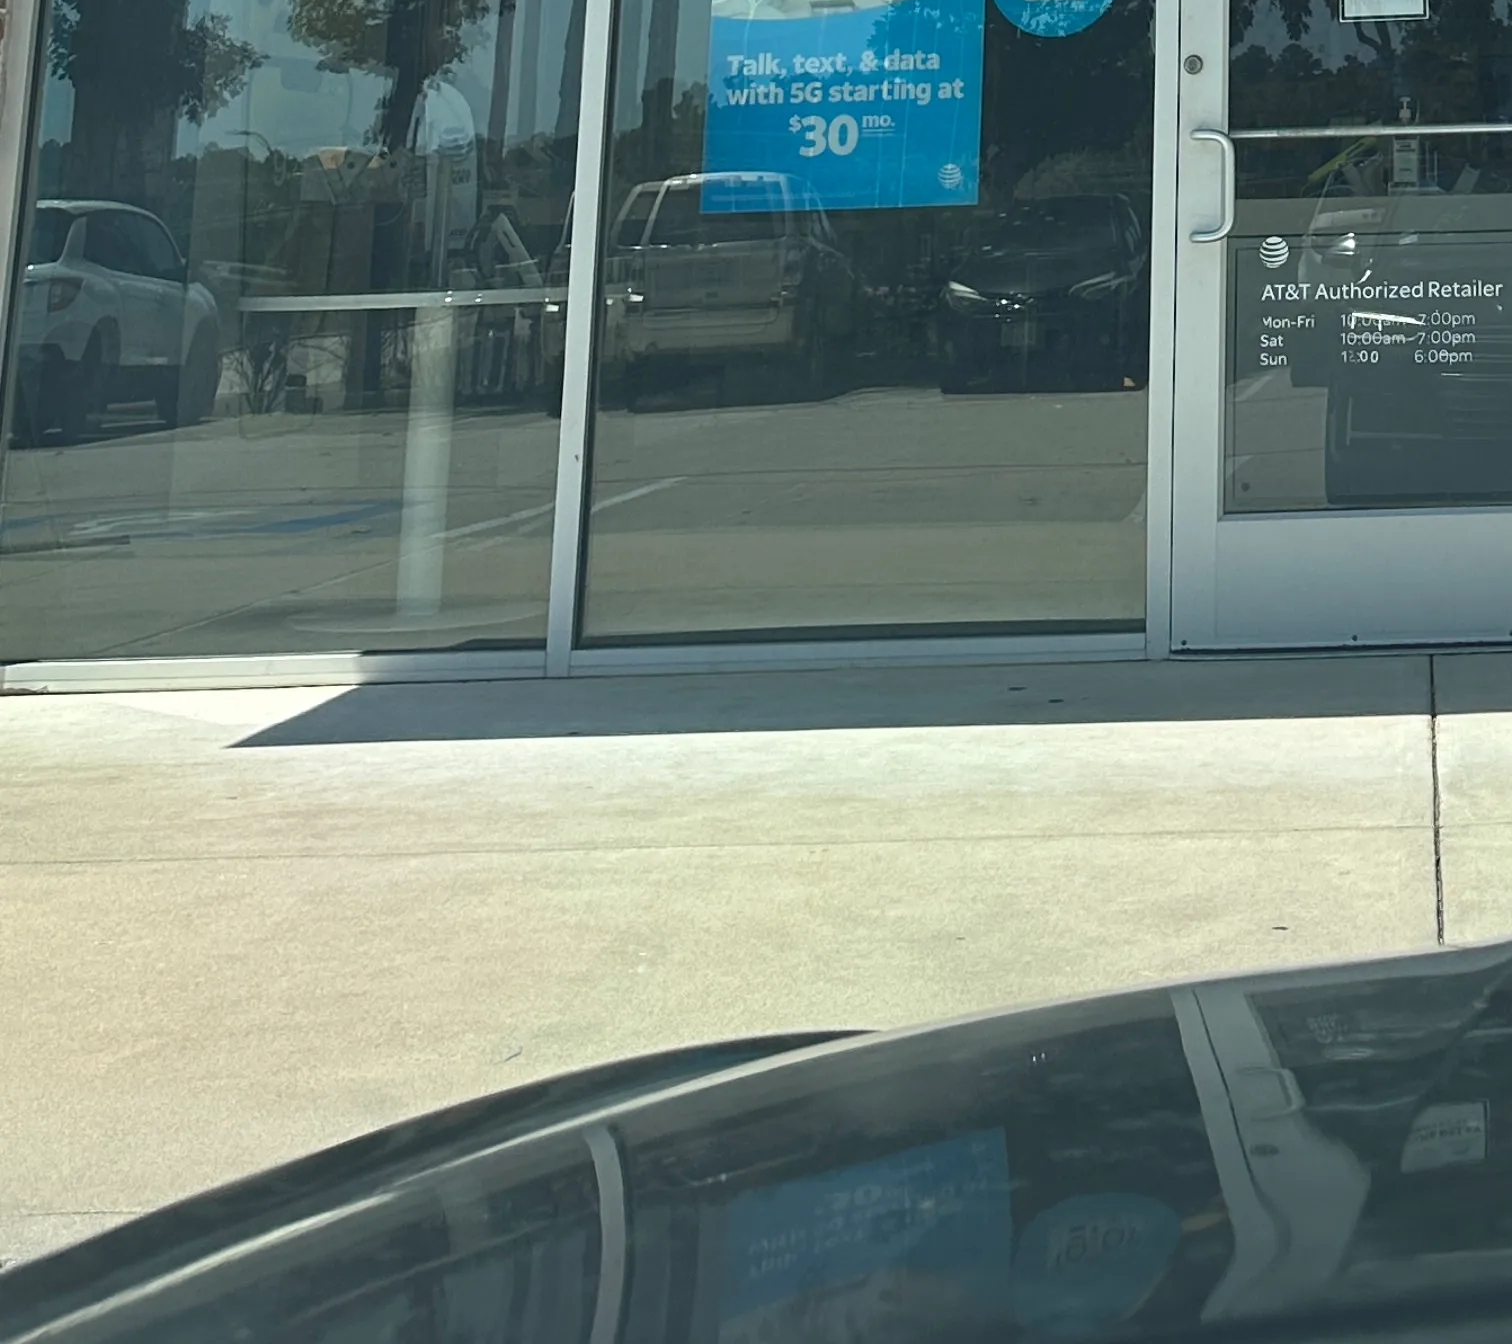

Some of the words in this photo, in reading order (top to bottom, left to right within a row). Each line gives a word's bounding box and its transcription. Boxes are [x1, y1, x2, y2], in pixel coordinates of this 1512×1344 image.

[726, 52, 787, 79] Talk,
[792, 52, 853, 76] text,
[860, 50, 880, 72] &
[884, 48, 941, 71] data
[726, 81, 784, 106] with
[790, 81, 823, 104] 5G
[828, 78, 932, 105] starting
[938, 78, 965, 100] at
[1261, 283, 1311, 301] AT&T
[1315, 280, 1424, 300] Authorized
[1428, 279, 1504, 298] Retailer
[1262, 315, 1316, 330] Mon-Fri
[1260, 334, 1284, 348] Sat
[1259, 351, 1288, 366] Sun
[1414, 348, 1473, 366] 6:00pm
